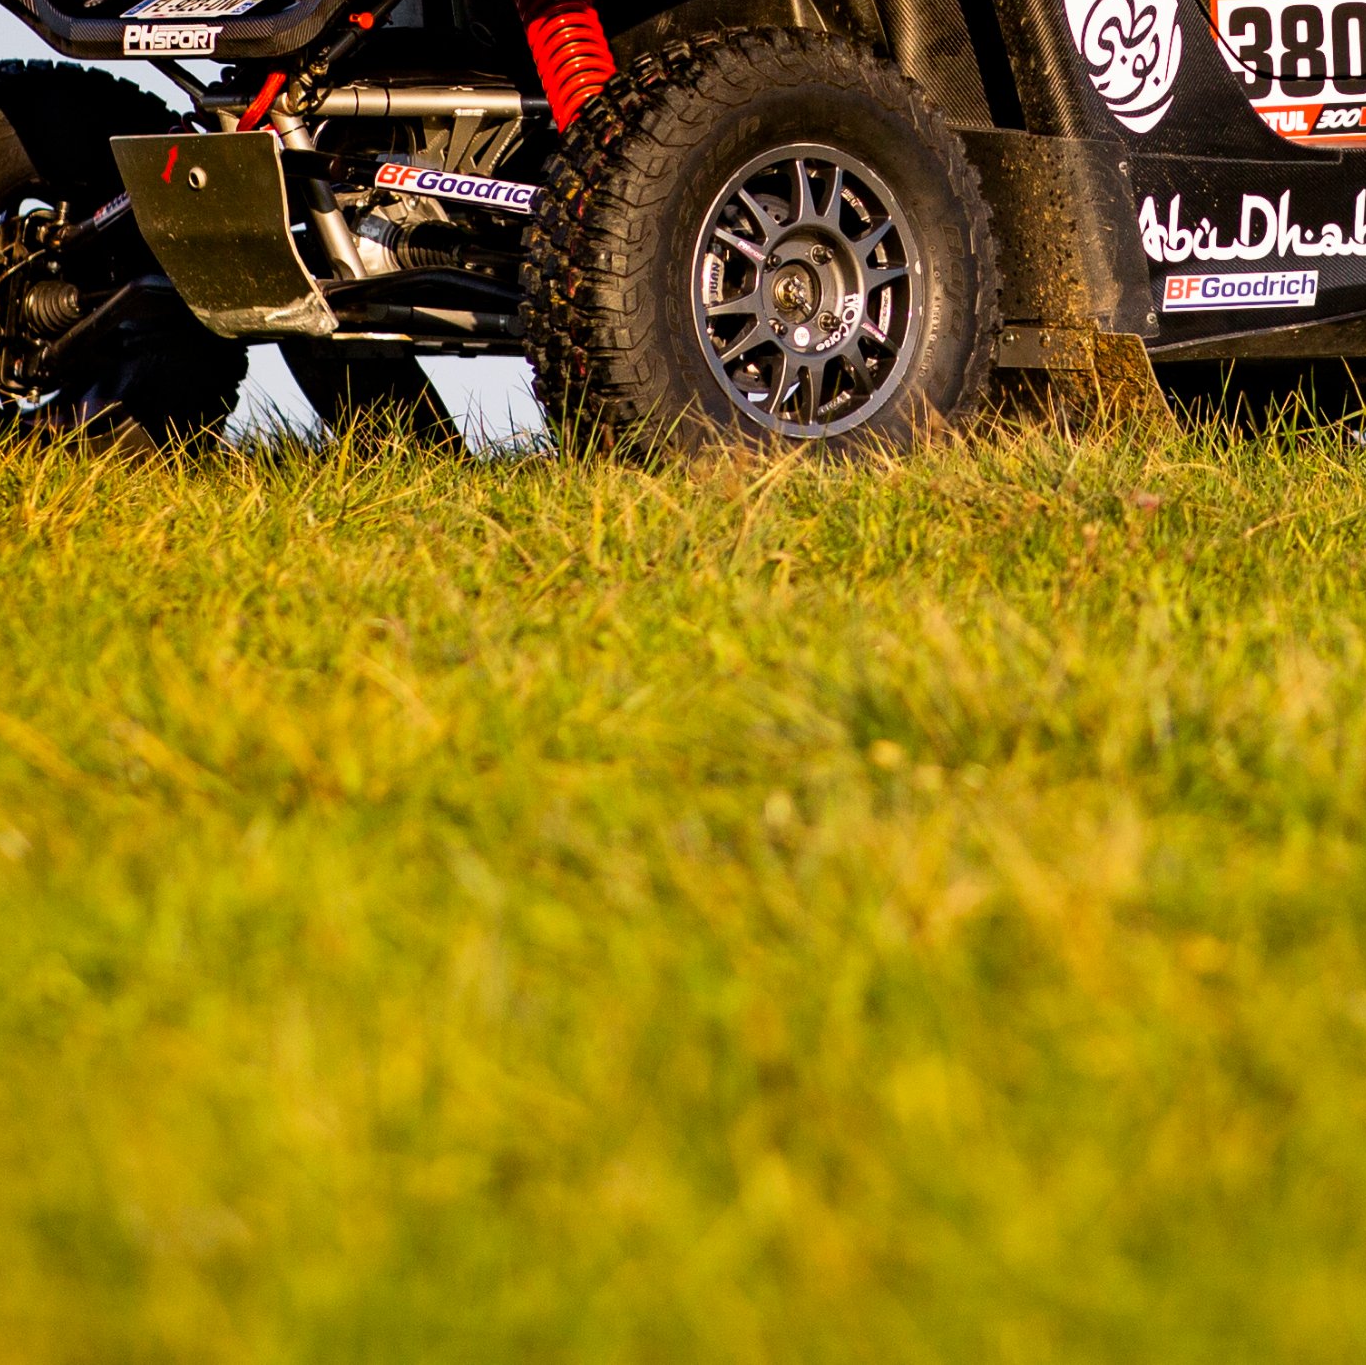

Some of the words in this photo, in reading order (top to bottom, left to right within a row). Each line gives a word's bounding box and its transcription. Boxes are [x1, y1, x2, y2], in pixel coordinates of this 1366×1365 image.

[124, 24, 223, 52] PHSPORT
[1259, 110, 1309, 132] TUL
[1138, 193, 1236, 263] Abu
[1166, 273, 1315, 300] BFGoodrich
